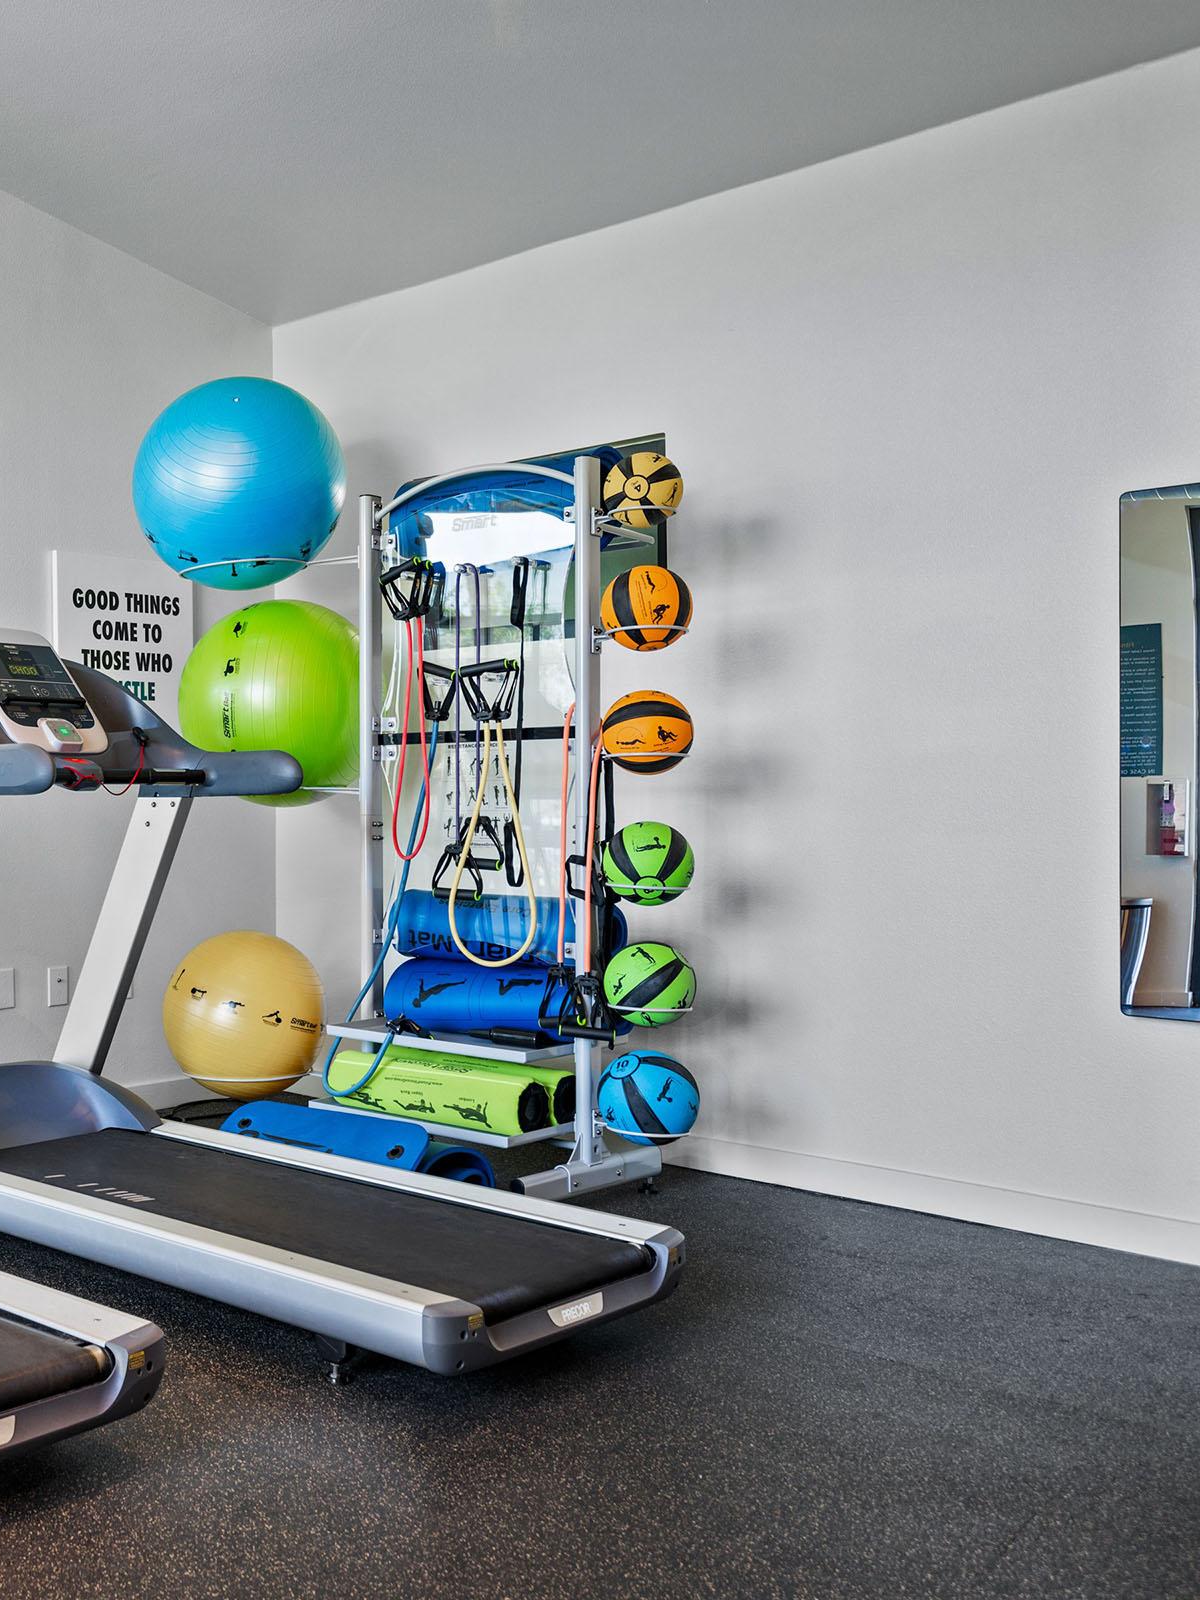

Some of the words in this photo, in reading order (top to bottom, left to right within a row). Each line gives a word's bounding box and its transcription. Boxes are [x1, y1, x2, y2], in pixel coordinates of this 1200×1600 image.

[451, 514, 499, 533] Smart
[72, 588, 120, 611] GOOD
[124, 592, 180, 616] THINGS
[92, 620, 138, 642] COME
[143, 623, 162, 644] TO
[81, 649, 130, 671] THOSE
[135, 652, 173, 673] WHO
[408, 929, 453, 953] Mat
[616, 1059, 629, 1069] 10
